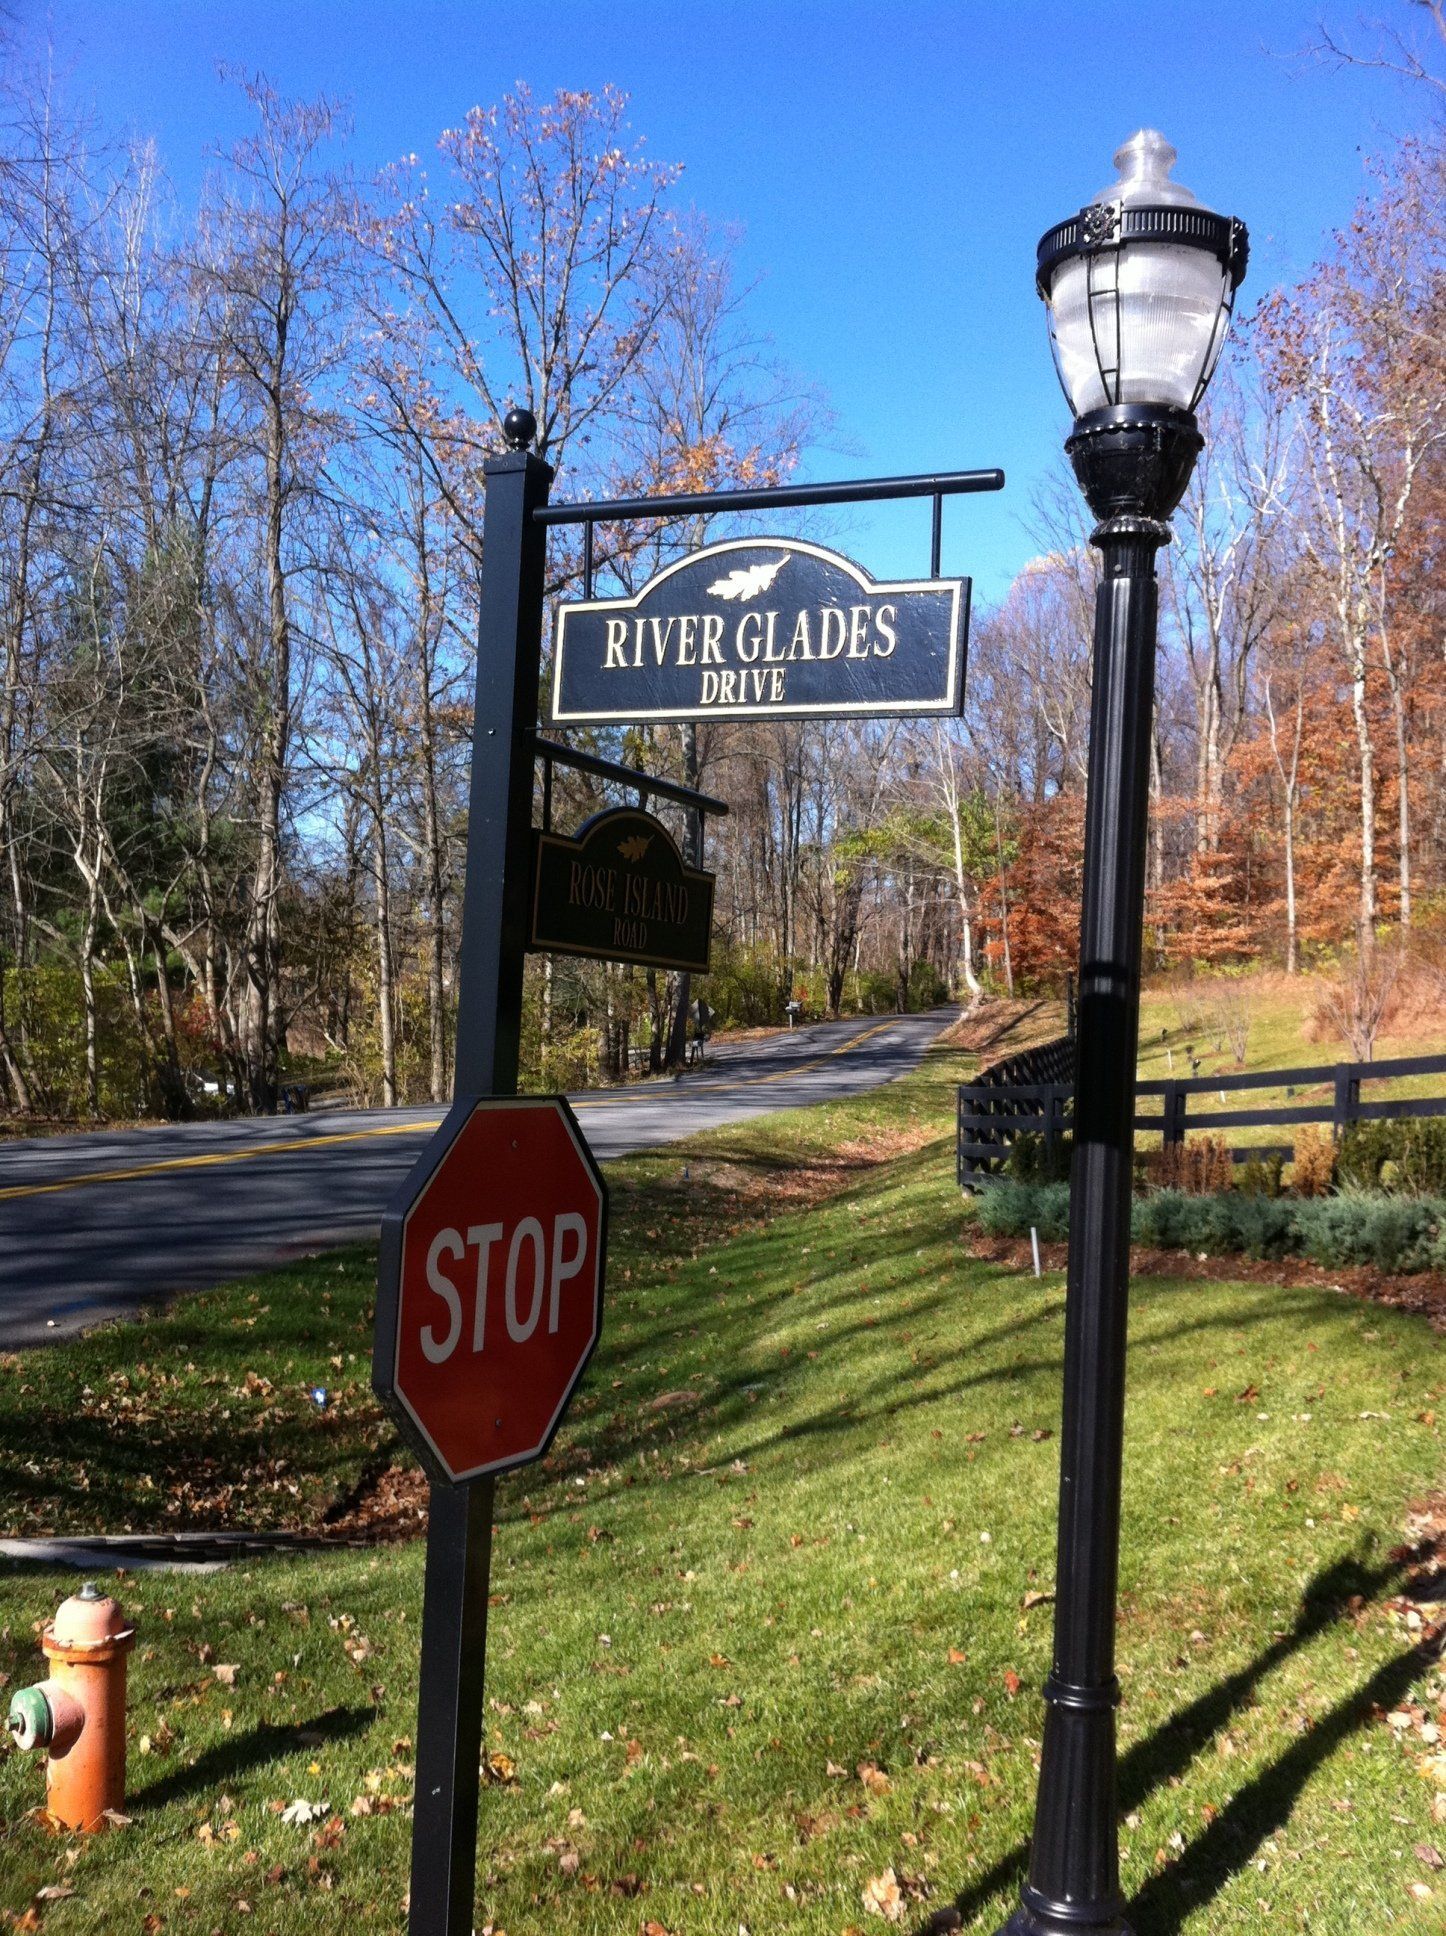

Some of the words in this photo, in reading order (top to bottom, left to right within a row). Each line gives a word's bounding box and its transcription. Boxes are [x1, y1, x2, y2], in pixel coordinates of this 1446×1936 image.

[604, 614, 727, 669] RIVER
[736, 605, 897, 663] GLADES
[700, 668, 786, 704] DRIVE
[569, 860, 617, 912] ROSE
[624, 873, 688, 925] ISLAND
[613, 917, 648, 949] ROAD
[420, 1212, 588, 1364] STOP
